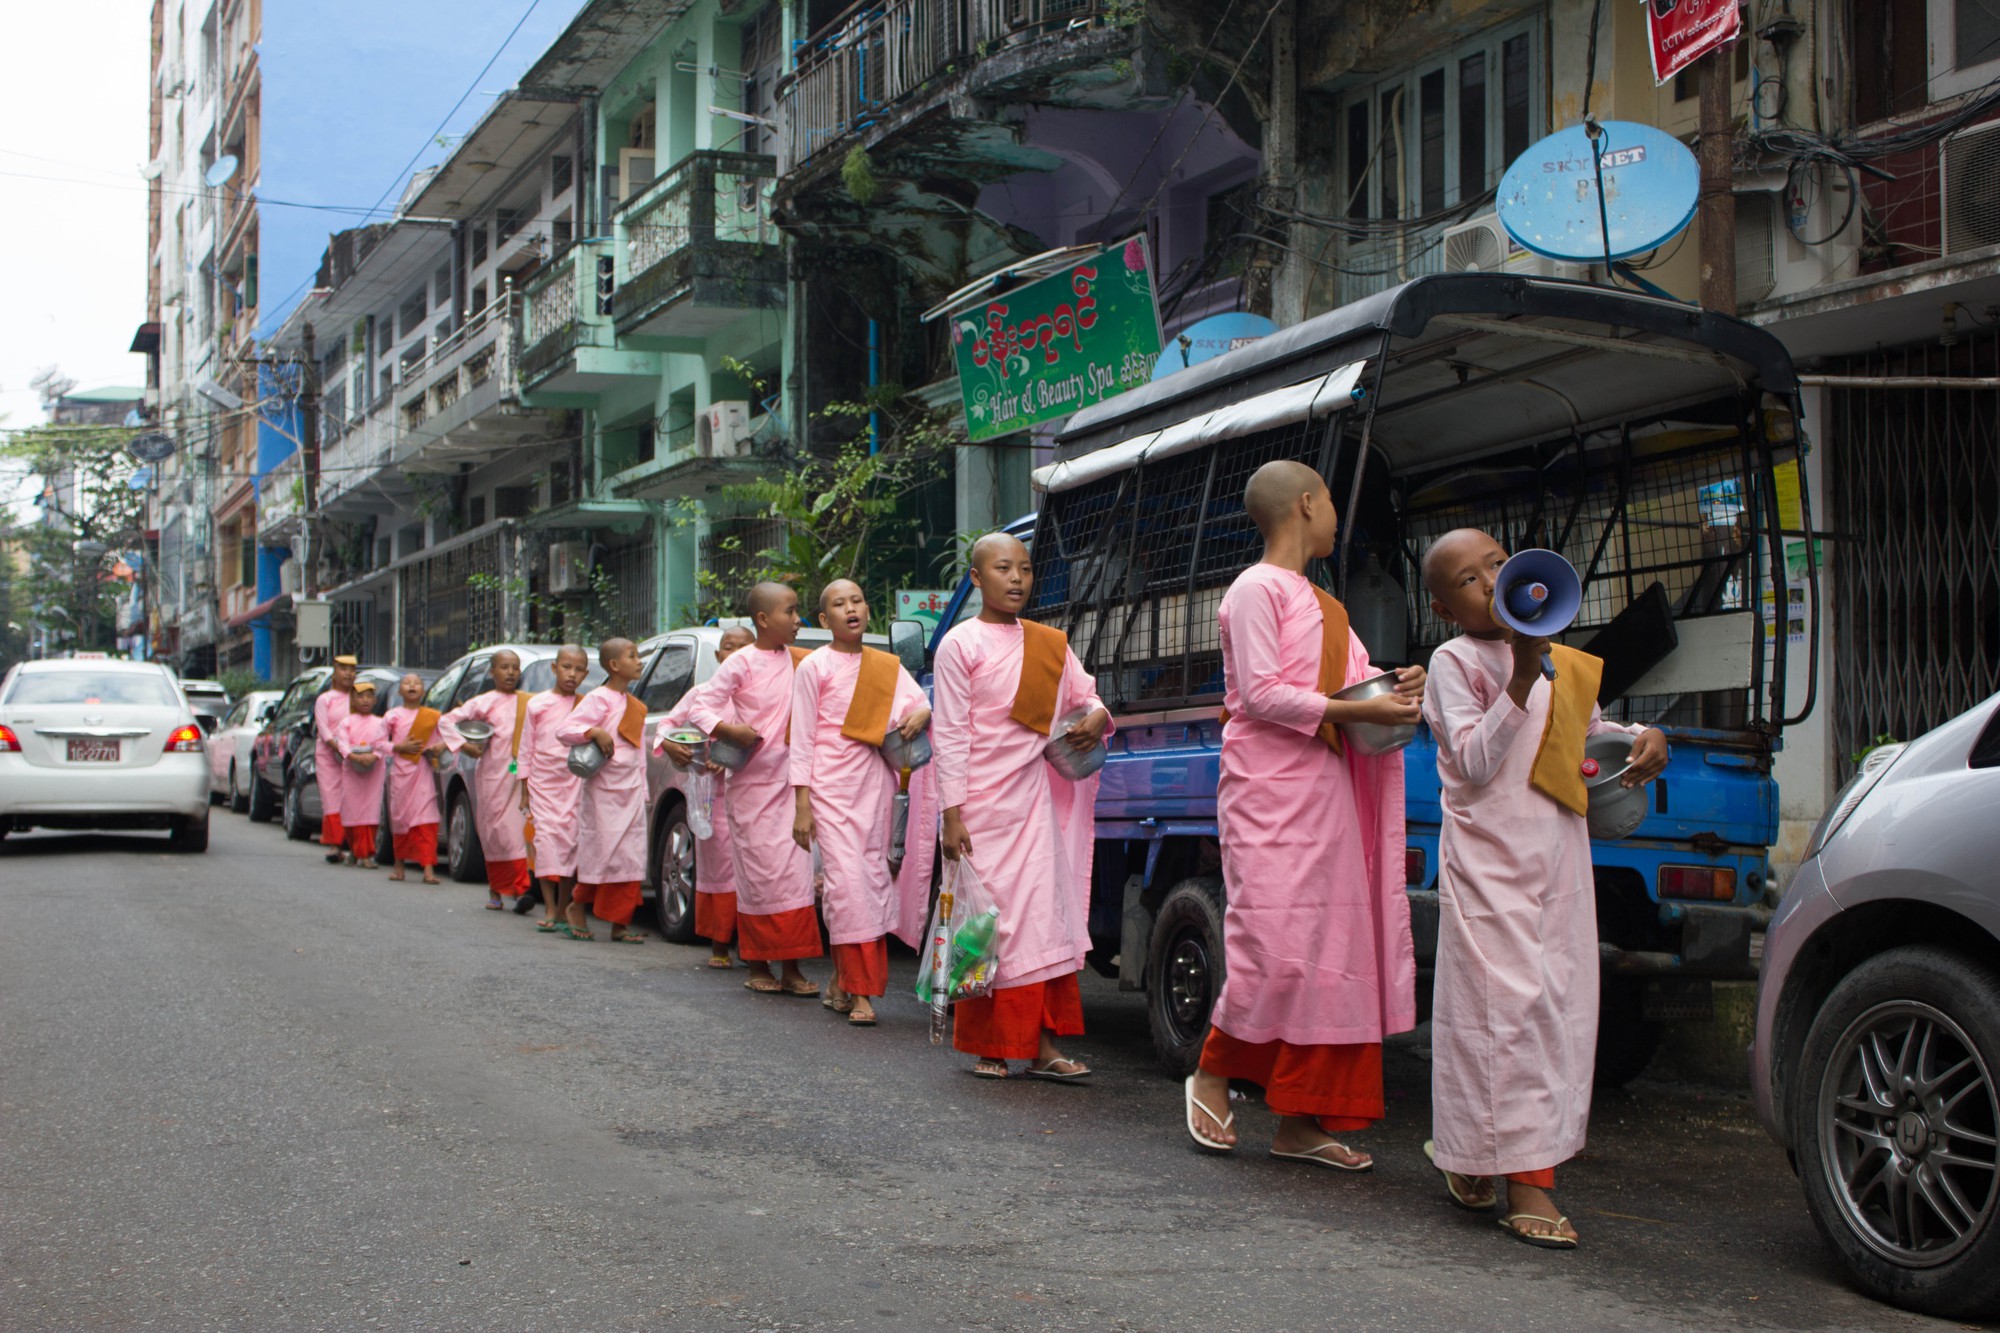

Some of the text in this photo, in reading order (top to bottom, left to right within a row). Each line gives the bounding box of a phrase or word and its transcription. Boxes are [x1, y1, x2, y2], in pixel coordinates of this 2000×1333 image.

[1661, 28, 1686, 52] CCTV
[989, 361, 1115, 424] Hair & Beauty Spa
